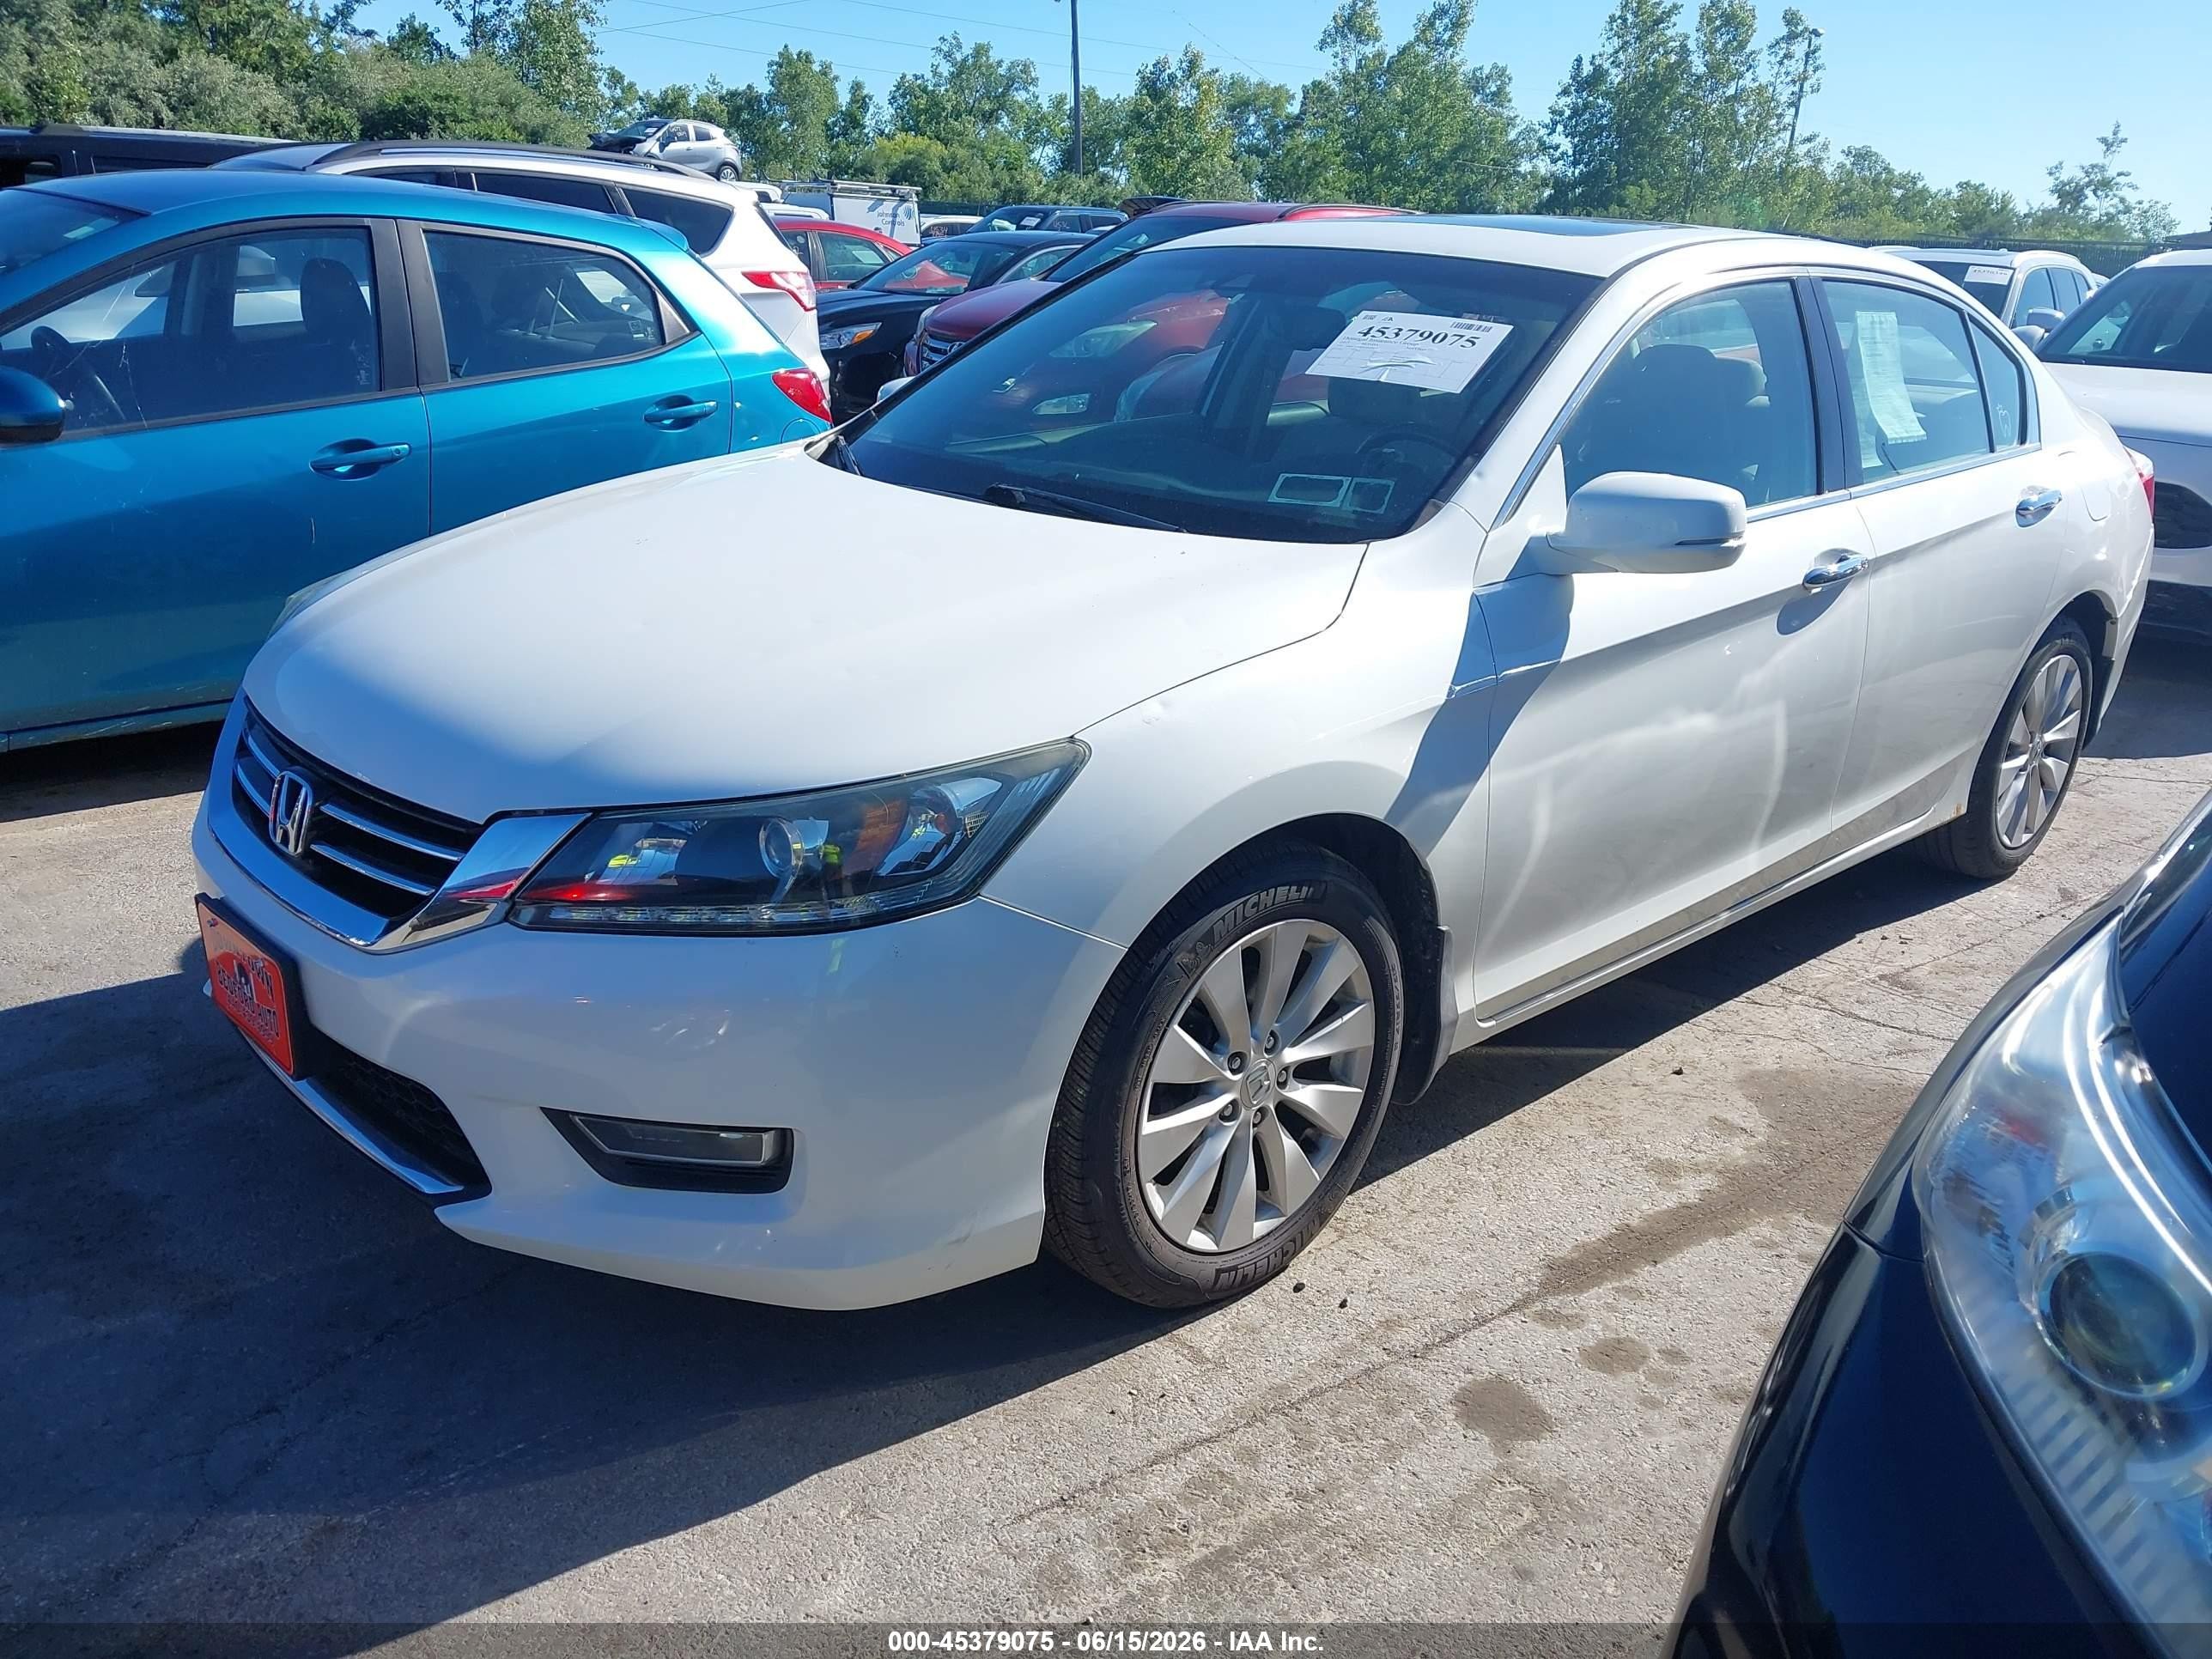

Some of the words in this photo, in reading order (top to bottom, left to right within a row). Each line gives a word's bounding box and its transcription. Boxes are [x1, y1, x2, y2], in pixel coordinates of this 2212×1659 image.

[877, 210, 901, 218] Johnson
[881, 218, 905, 227] Controls
[1357, 325, 1480, 349] 45379075
[1212, 881, 1328, 943] MICHELIN
[1212, 1215, 1321, 1291] MICHELIN
